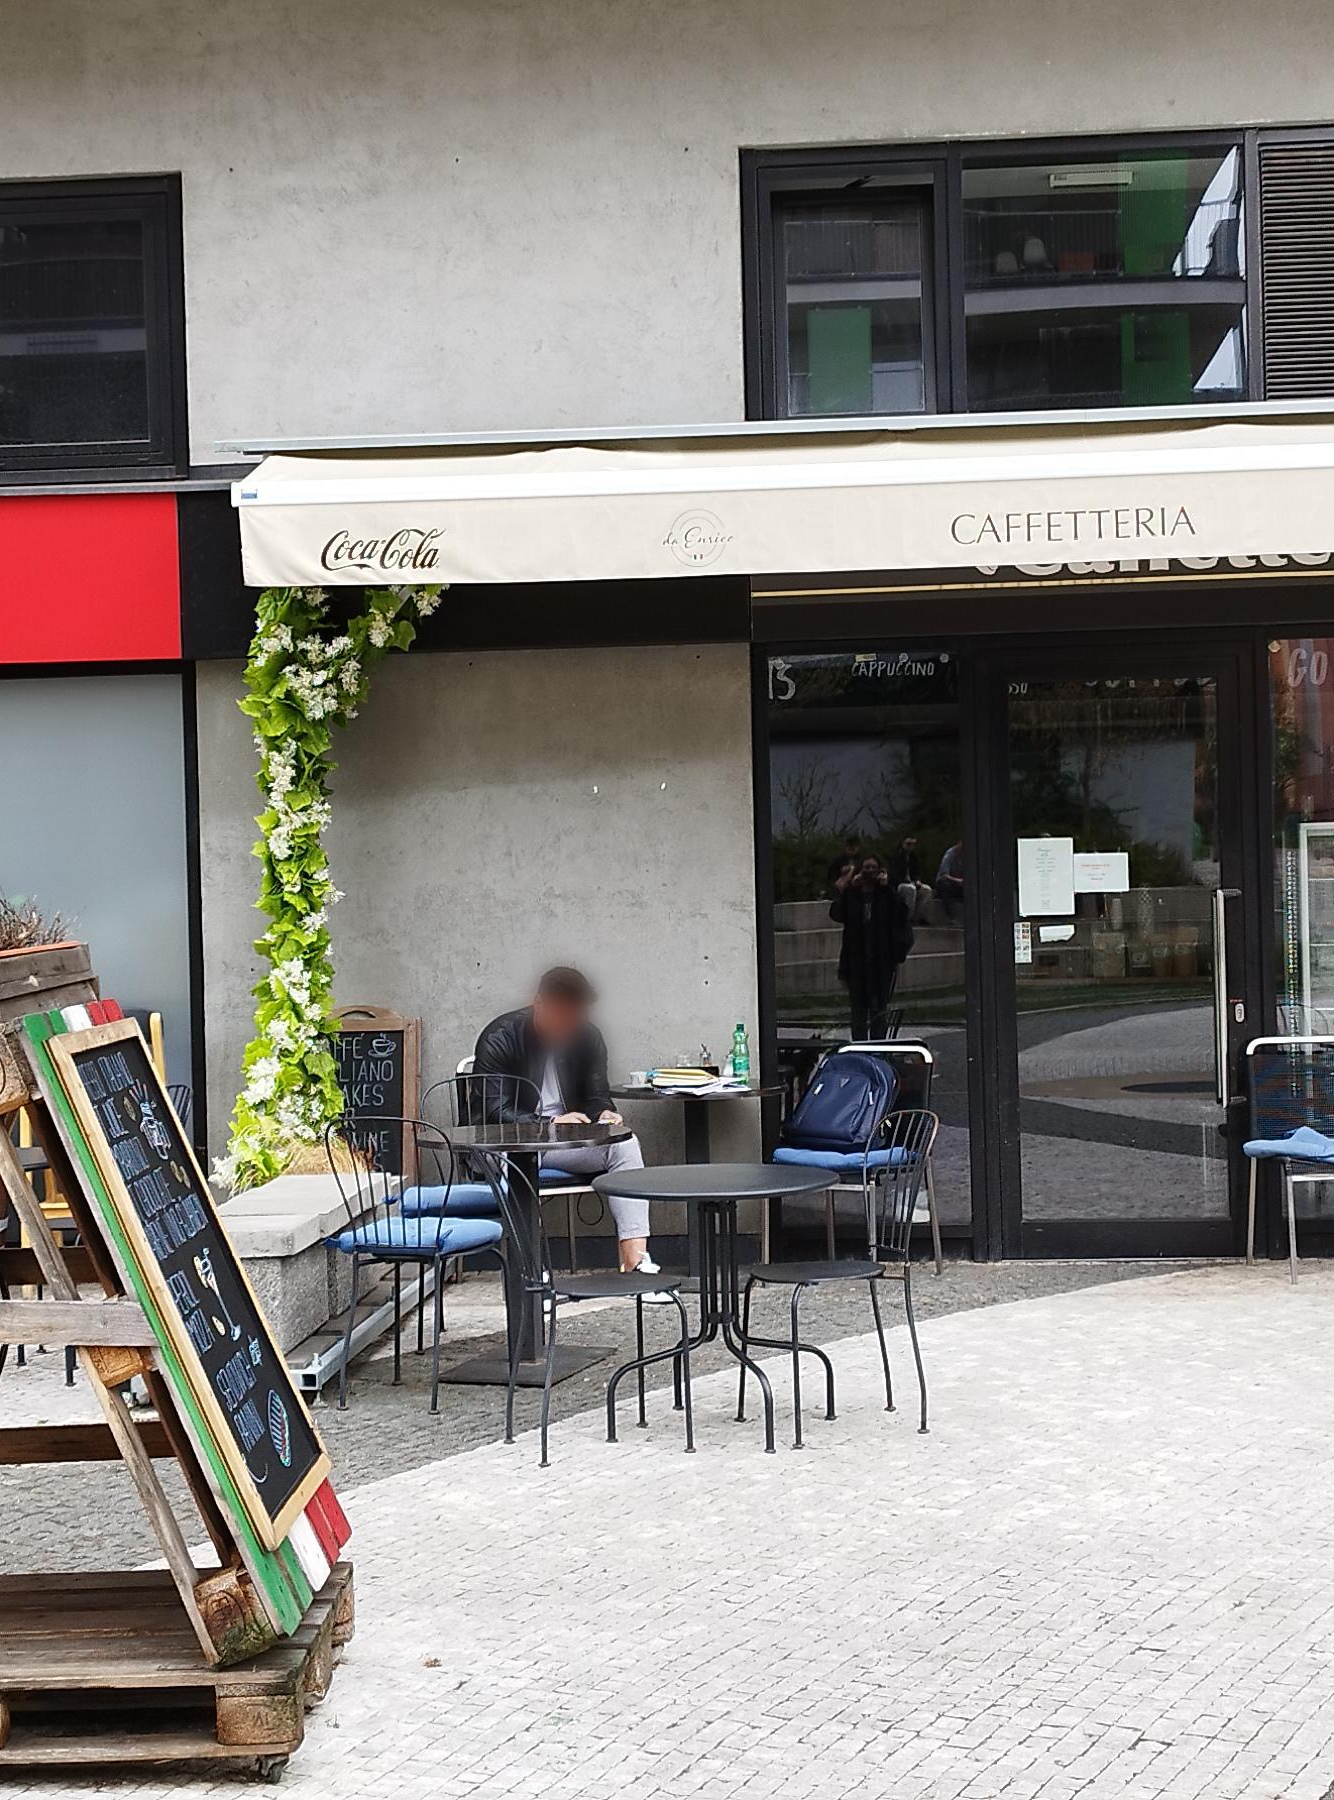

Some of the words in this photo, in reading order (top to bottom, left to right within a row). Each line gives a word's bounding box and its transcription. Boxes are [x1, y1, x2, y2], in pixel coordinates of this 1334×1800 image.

[951, 506, 1196, 545] CAFFETTERIA
[320, 528, 446, 571] Coca-Cola
[852, 661, 935, 678] CAPPUCCINO
[1288, 648, 1328, 687] GO
[338, 1060, 394, 1082] LIANO
[343, 1084, 385, 1107] AKES
